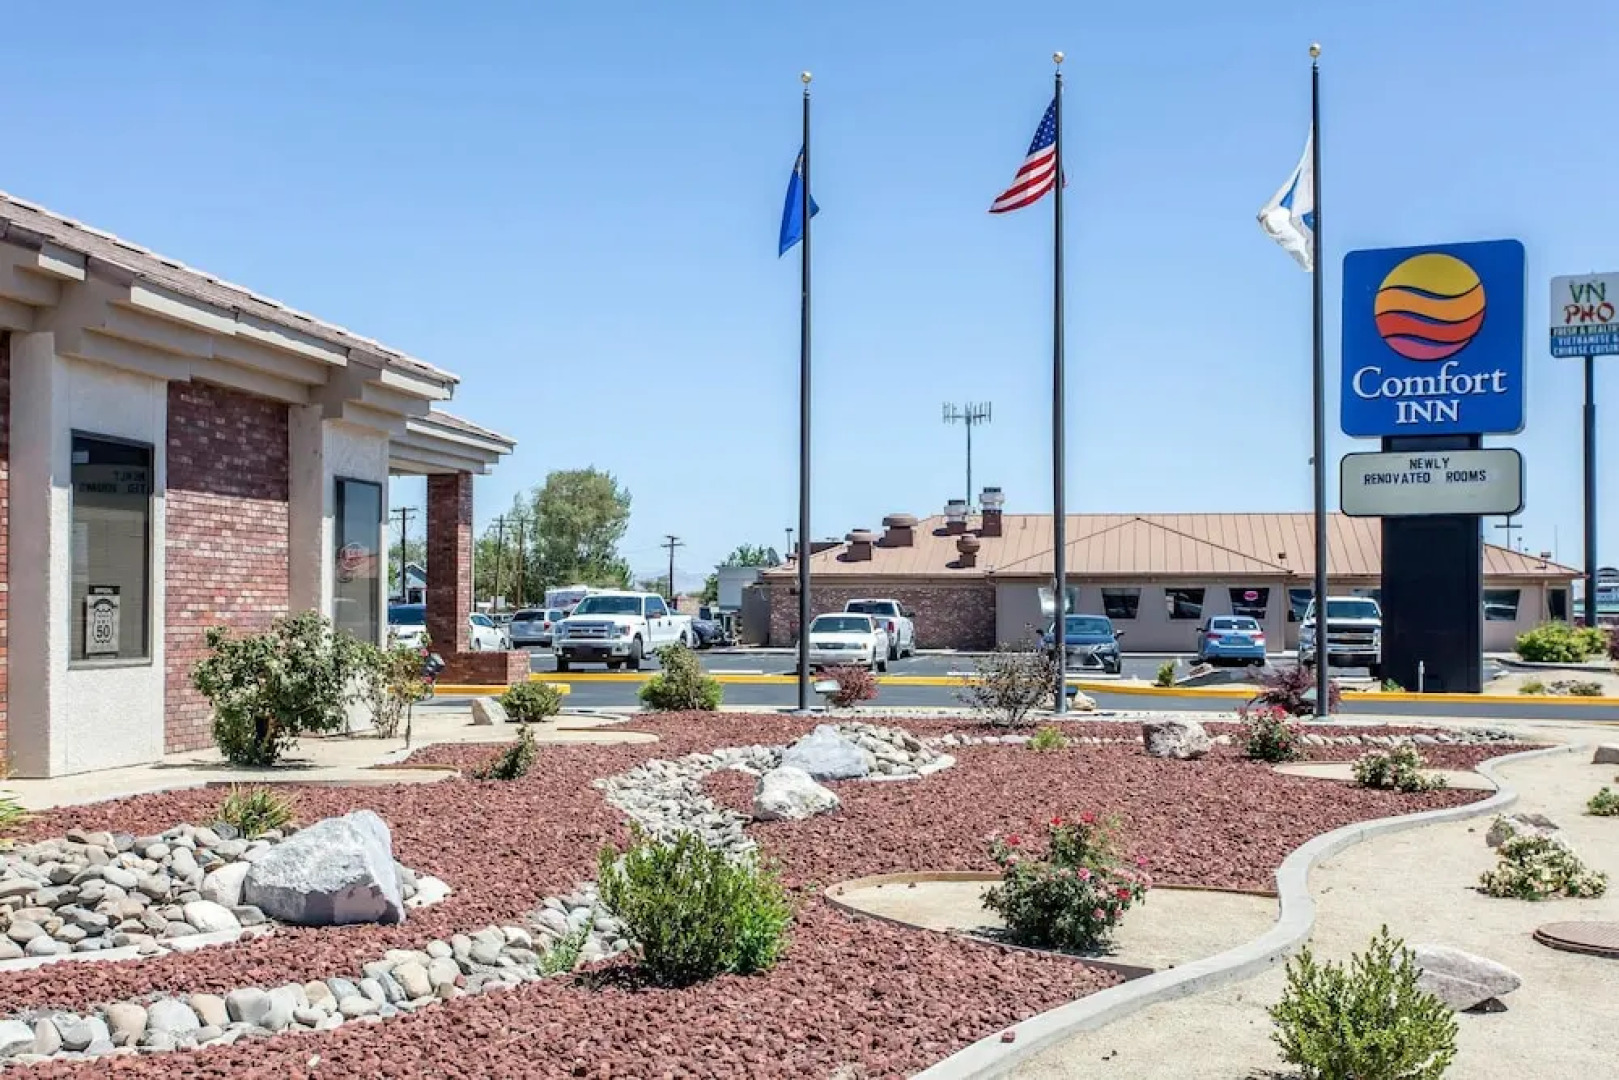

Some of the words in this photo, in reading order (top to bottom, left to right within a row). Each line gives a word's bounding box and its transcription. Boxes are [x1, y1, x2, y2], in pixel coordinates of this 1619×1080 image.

[1569, 282, 1606, 303] VN
[1564, 303, 1615, 324] PHO
[1353, 361, 1507, 398] Comfort
[1396, 399, 1461, 424] INN
[1409, 457, 1450, 470] NEWLY
[1364, 472, 1431, 485] RENOVATED
[1446, 470, 1487, 483] ROOMS
